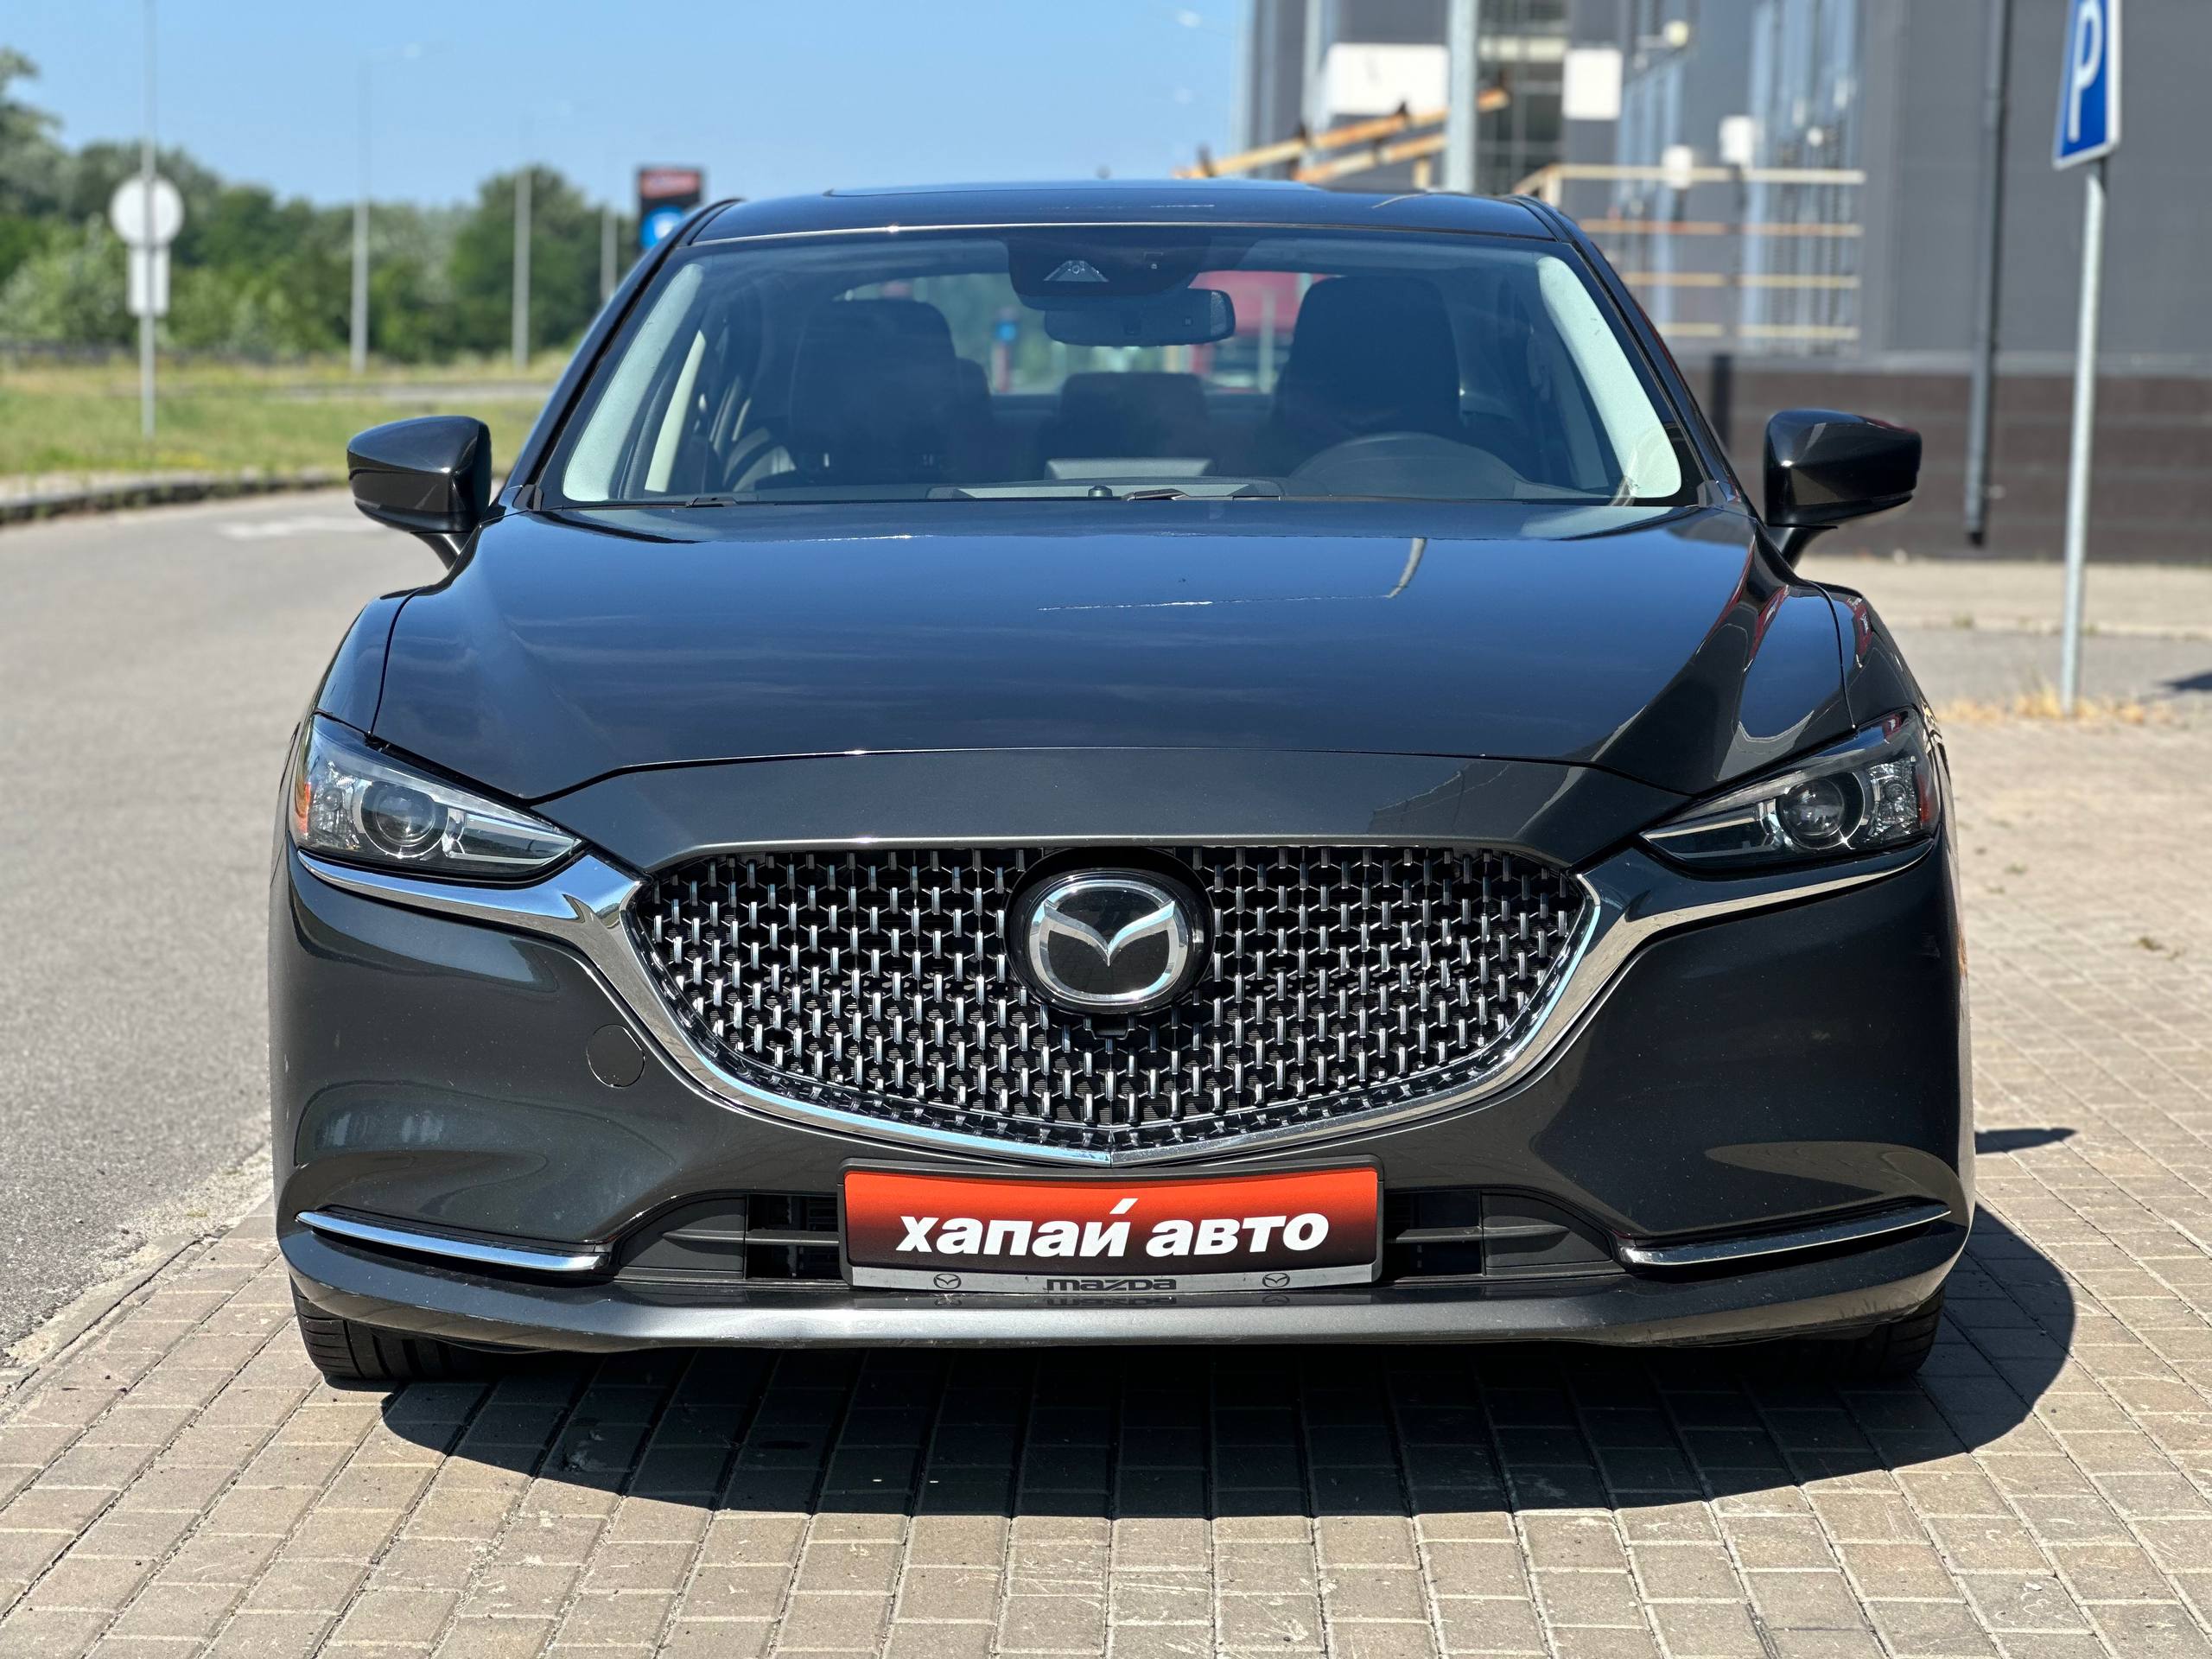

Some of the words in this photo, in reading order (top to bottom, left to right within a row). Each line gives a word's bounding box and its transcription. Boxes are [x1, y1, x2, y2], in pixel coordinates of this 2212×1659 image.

[2068, 0, 2103, 143] P
[895, 1198, 1139, 1258] хапай
[1146, 1212, 1329, 1258] авто
